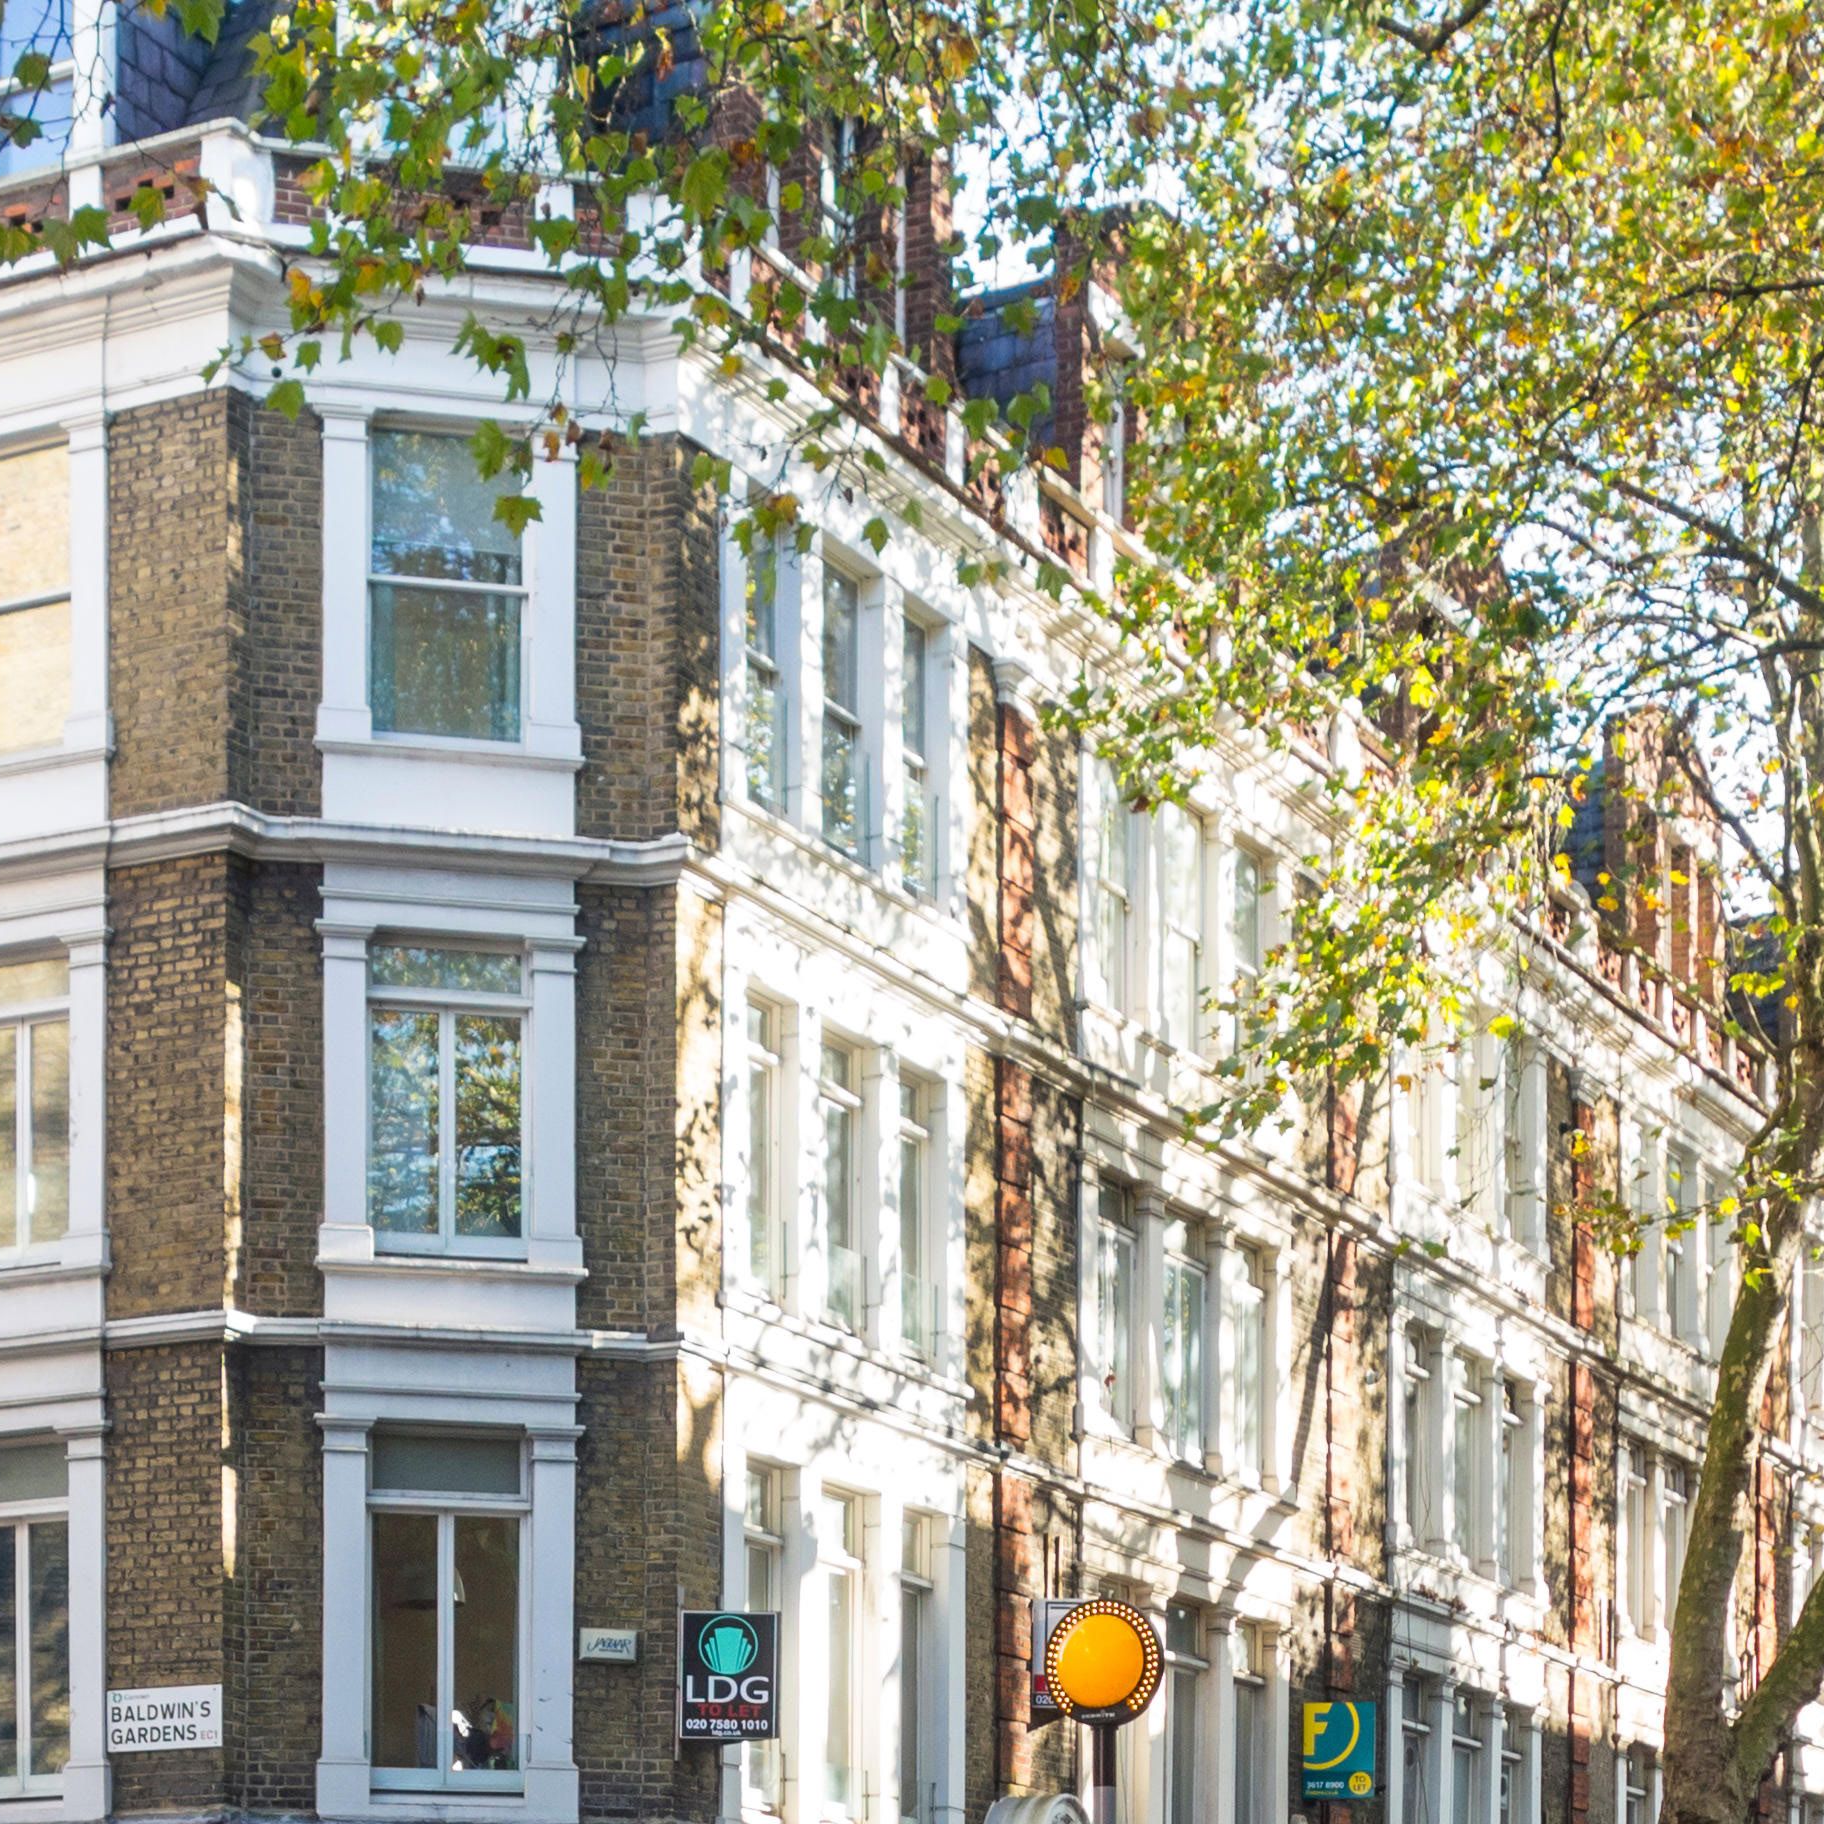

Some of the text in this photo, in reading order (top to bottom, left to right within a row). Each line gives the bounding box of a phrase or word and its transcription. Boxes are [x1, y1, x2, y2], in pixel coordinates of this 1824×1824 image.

[685, 1675, 770, 1704] LDG
[111, 1701, 212, 1723] BALDWIN'S
[697, 1704, 763, 1718] TO LET
[111, 1724, 218, 1745] GARDENS EC1
[686, 1719, 769, 1731] 020 7580 1010
